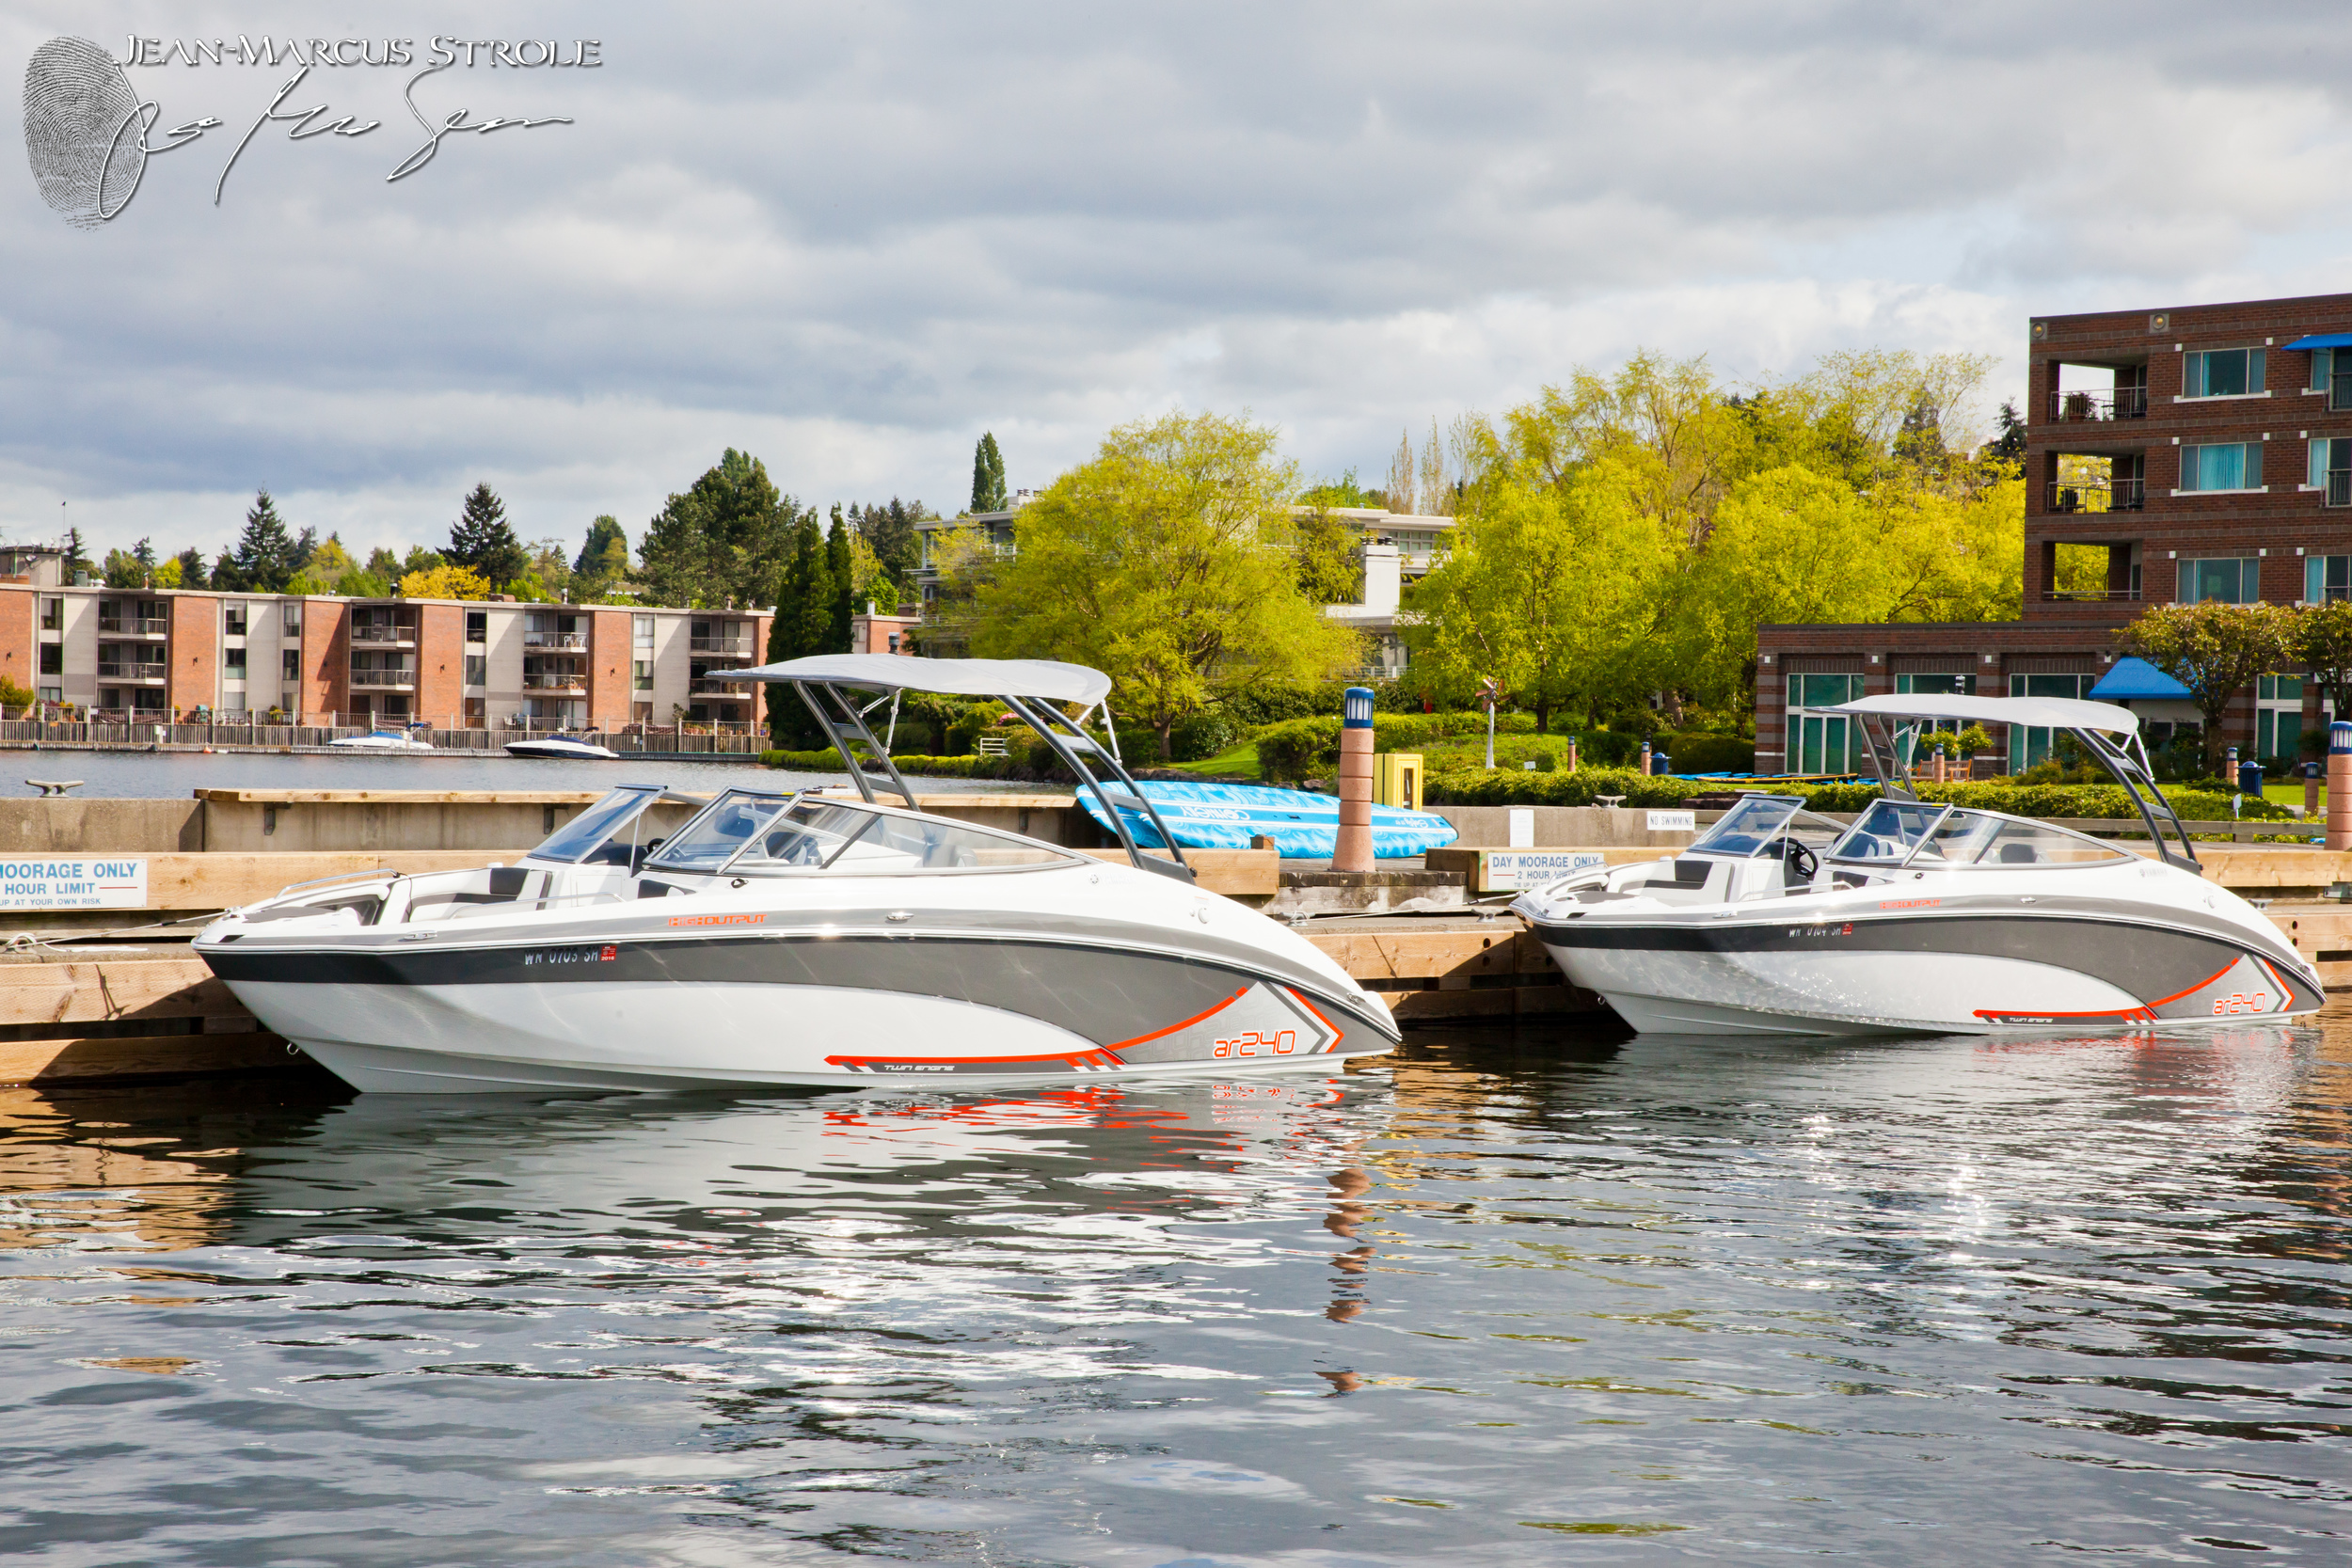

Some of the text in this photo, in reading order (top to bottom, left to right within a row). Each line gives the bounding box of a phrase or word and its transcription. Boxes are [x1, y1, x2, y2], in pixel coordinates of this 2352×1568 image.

[1650, 816, 1692, 826] NO SWIMMING
[1492, 856, 1513, 867] DAY
[1518, 856, 1568, 867] MOORAGE
[0, 863, 137, 879] OORAGE ONLY
[1518, 871, 1522, 879] 2
[1527, 871, 1549, 879] HOUR
[5, 882, 95, 895] HOUR LIMIT
[2213, 992, 2266, 1014] ar240
[1214, 1029, 1296, 1058] ar240
